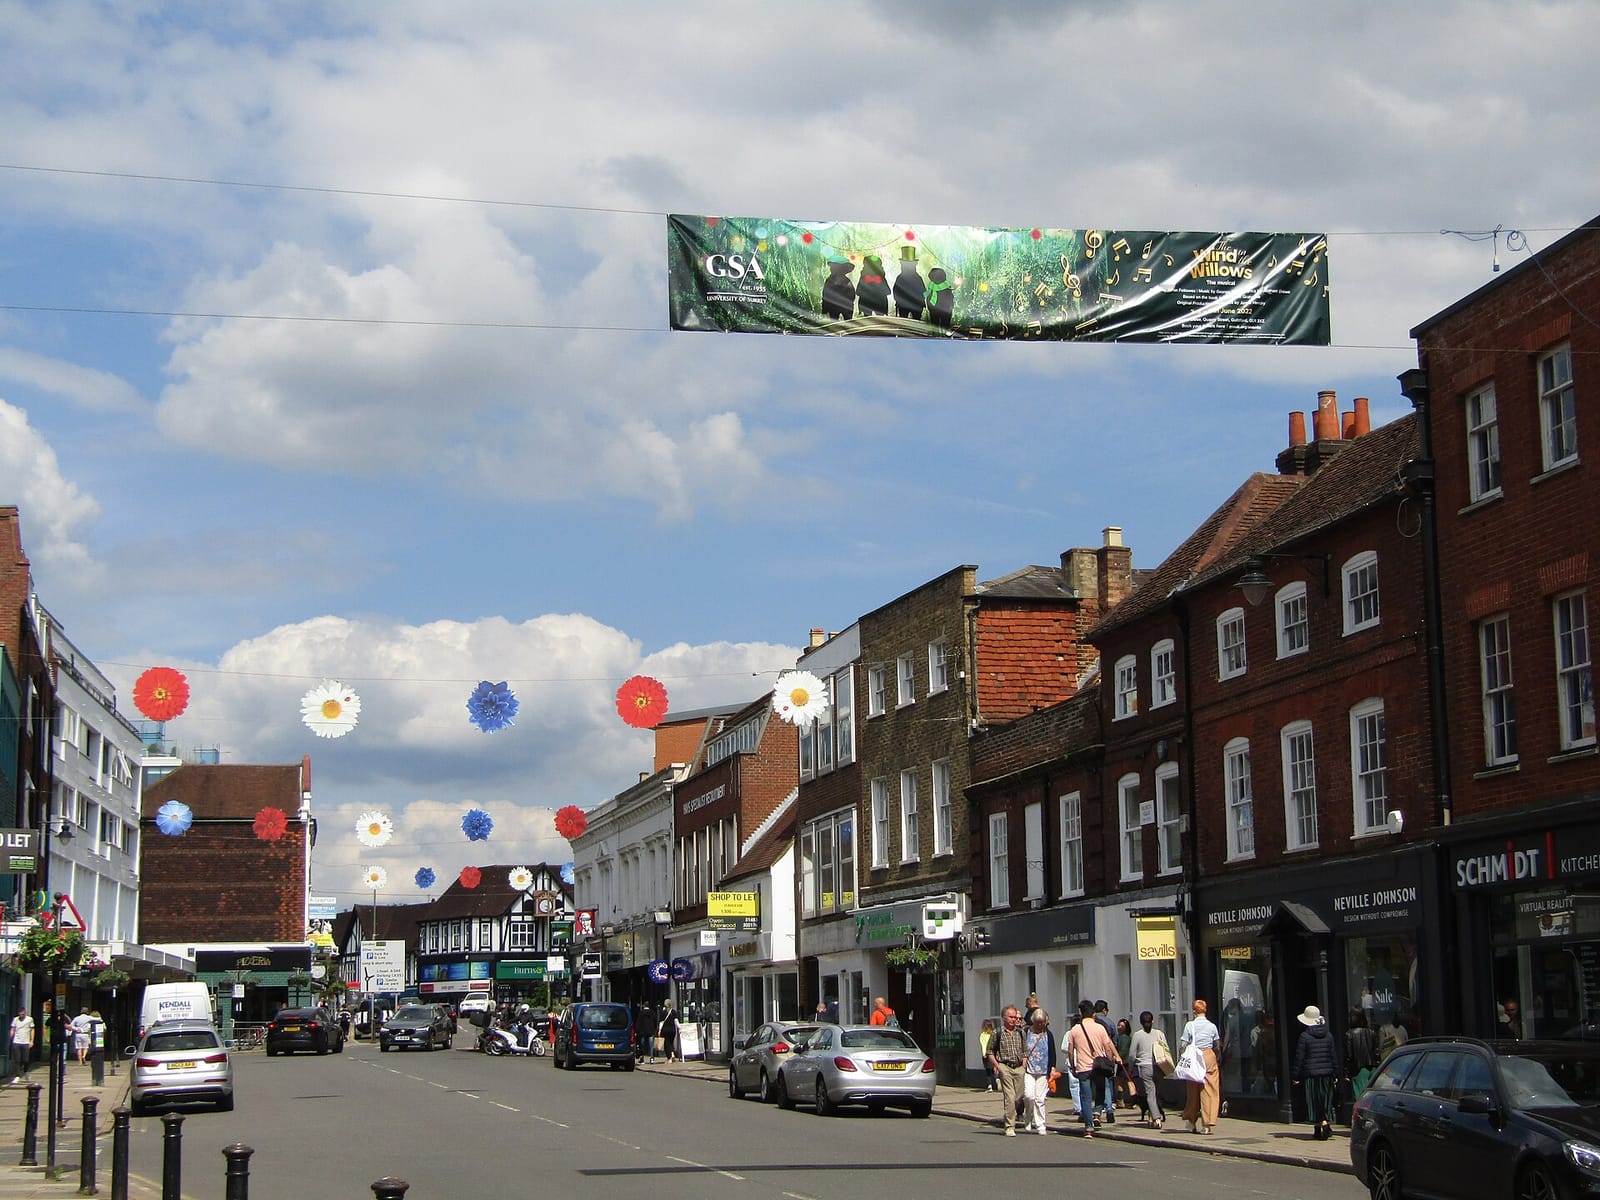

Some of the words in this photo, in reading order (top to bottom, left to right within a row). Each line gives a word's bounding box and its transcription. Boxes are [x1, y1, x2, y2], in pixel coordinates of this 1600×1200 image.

[706, 252, 766, 281] GSA
[1191, 262, 1253, 279] Willows
[8, 833, 31, 848] LET
[1561, 854, 1600, 873] KITCHE
[710, 893, 731, 901] SHOP
[732, 893, 742, 901] TO
[744, 893, 757, 901] LET
[1334, 893, 1370, 912] NEVILLE
[1372, 887, 1417, 907] JOHNSON
[1520, 900, 1546, 913] VIRTUAL
[1547, 898, 1574, 911] REALITY
[1208, 910, 1236, 925] NEVILLE
[1238, 905, 1272, 921] JOHNSON
[1140, 944, 1176, 958] savills
[1374, 988, 1393, 1004] Sale
[159, 1000, 192, 1011] KENDALL
